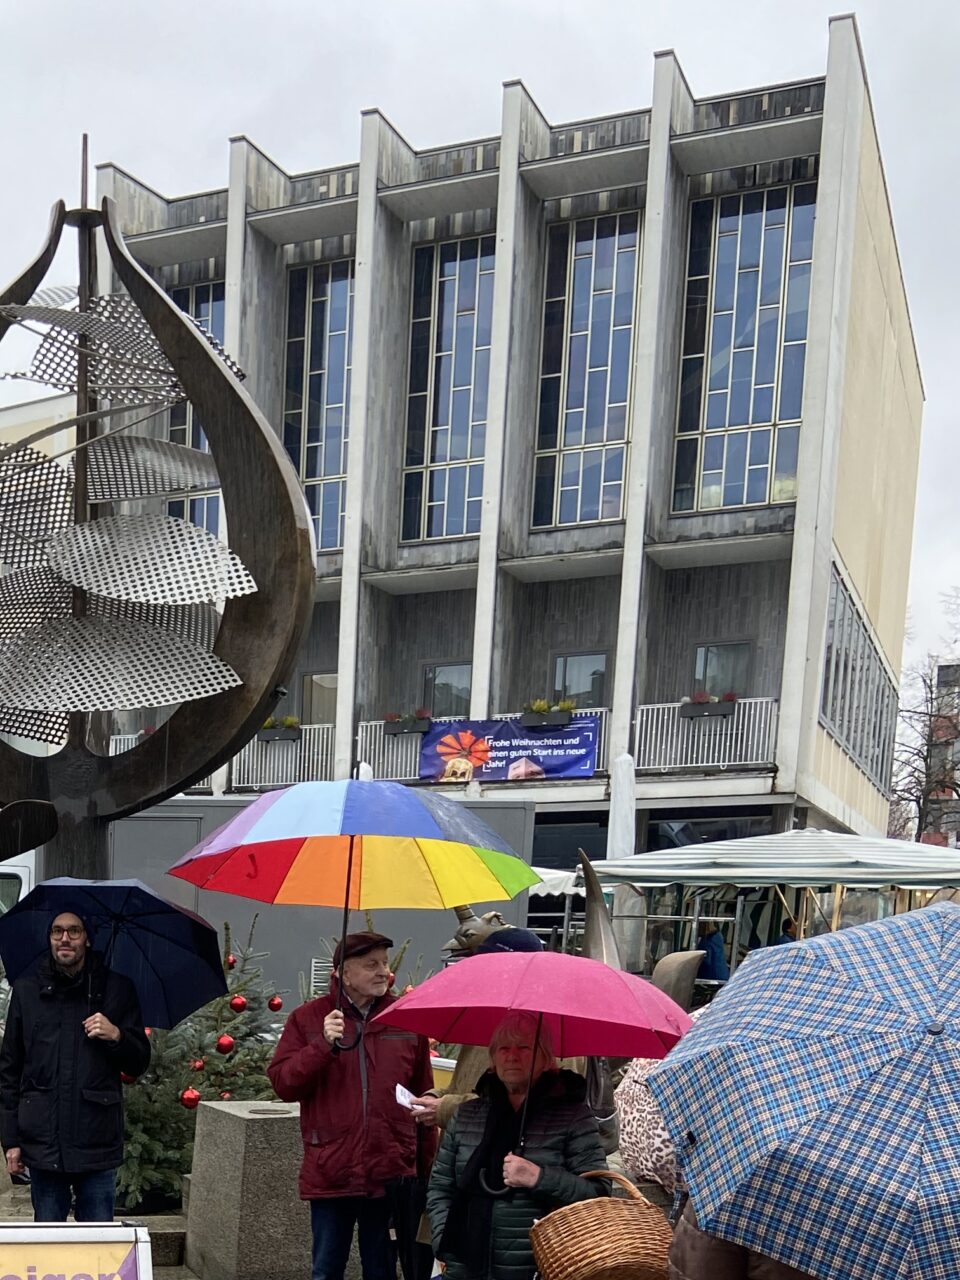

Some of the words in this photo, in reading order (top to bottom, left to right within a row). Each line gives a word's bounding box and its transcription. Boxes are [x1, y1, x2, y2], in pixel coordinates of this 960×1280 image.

[488, 739, 510, 747] Frohe
[512, 738, 562, 747] Weihnachten
[563, 737, 580, 745] und
[510, 750, 531, 758] guten
[533, 748, 552, 756] Start
[486, 760, 506, 768] Jahr!
